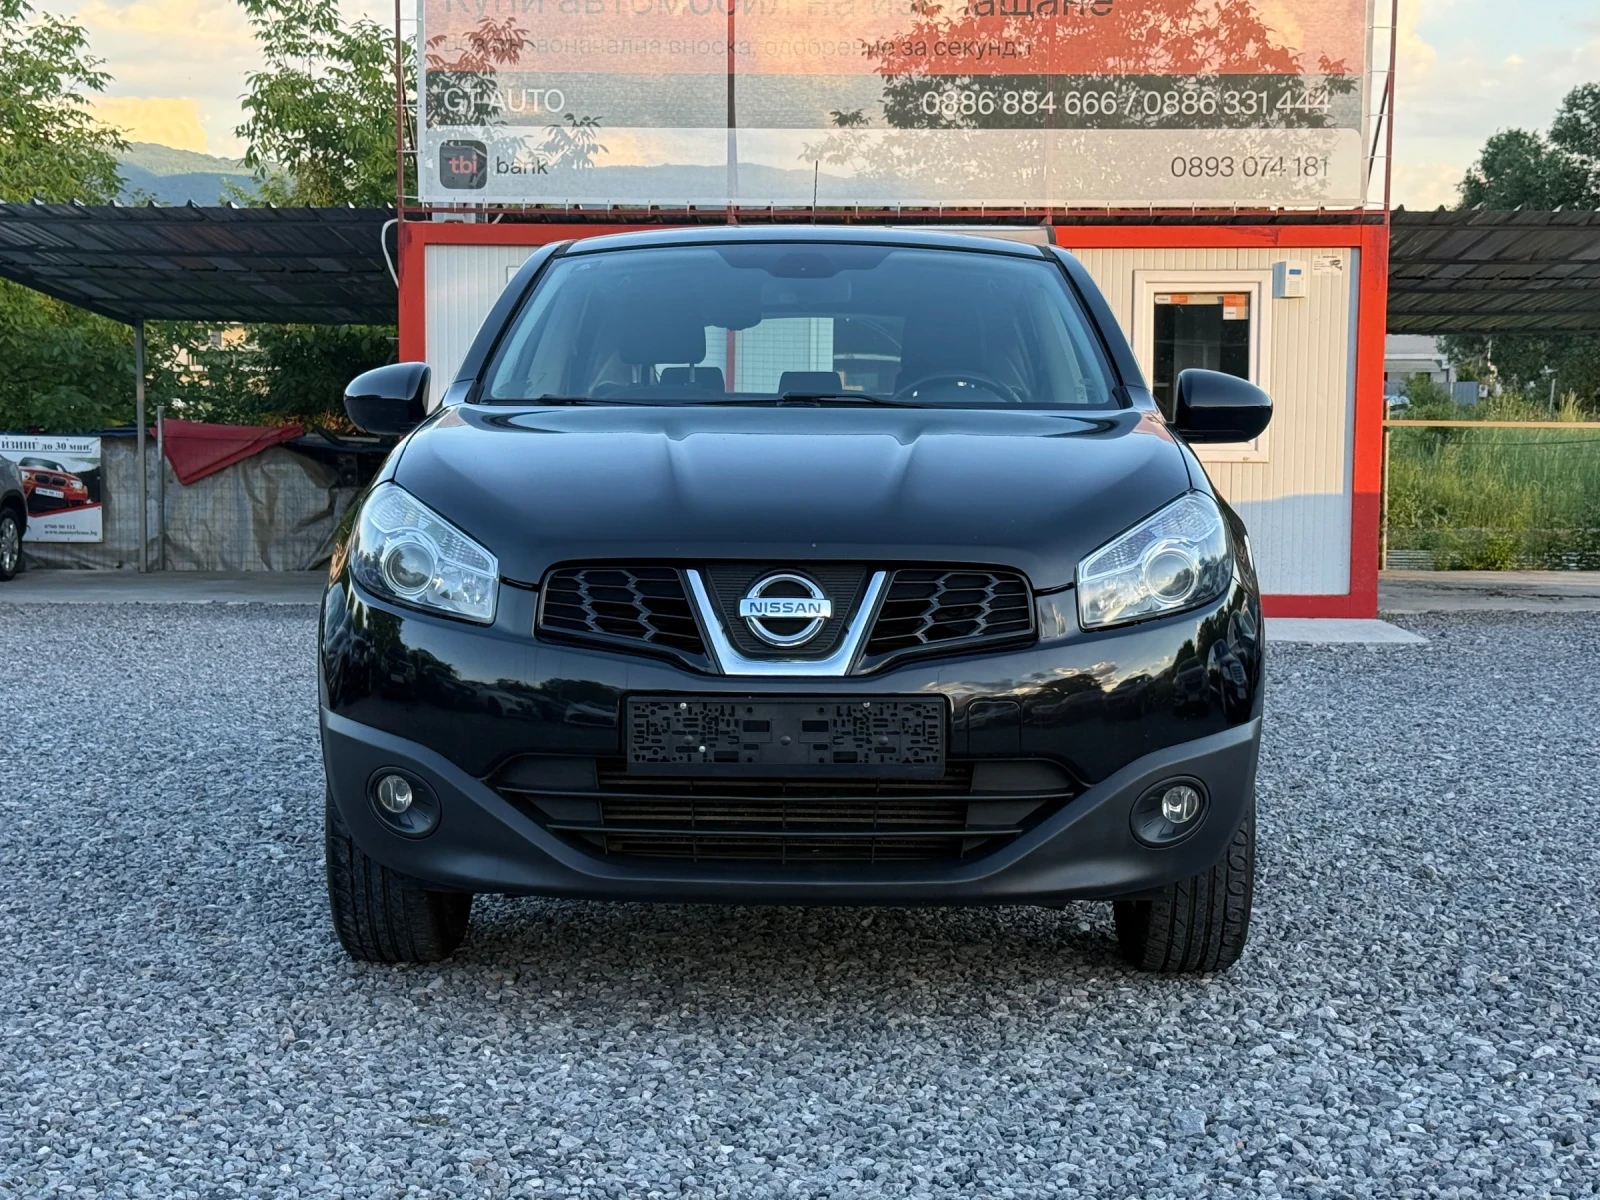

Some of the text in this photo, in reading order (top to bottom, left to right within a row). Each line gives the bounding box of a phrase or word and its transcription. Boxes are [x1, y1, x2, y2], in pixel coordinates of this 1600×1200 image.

[872, 0, 1113, 21] изащане
[901, 41, 927, 56] за
[933, 40, 1031, 60] секунди
[444, 88, 565, 112] GT AUTO
[923, 90, 1332, 115] 0886 884 666 / 0886 331 444
[449, 155, 478, 174] tbi
[496, 156, 548, 175] bank
[1171, 156, 1328, 177] 0893 074 181
[55, 442, 67, 451] 30
[749, 602, 822, 614] NISSAN
